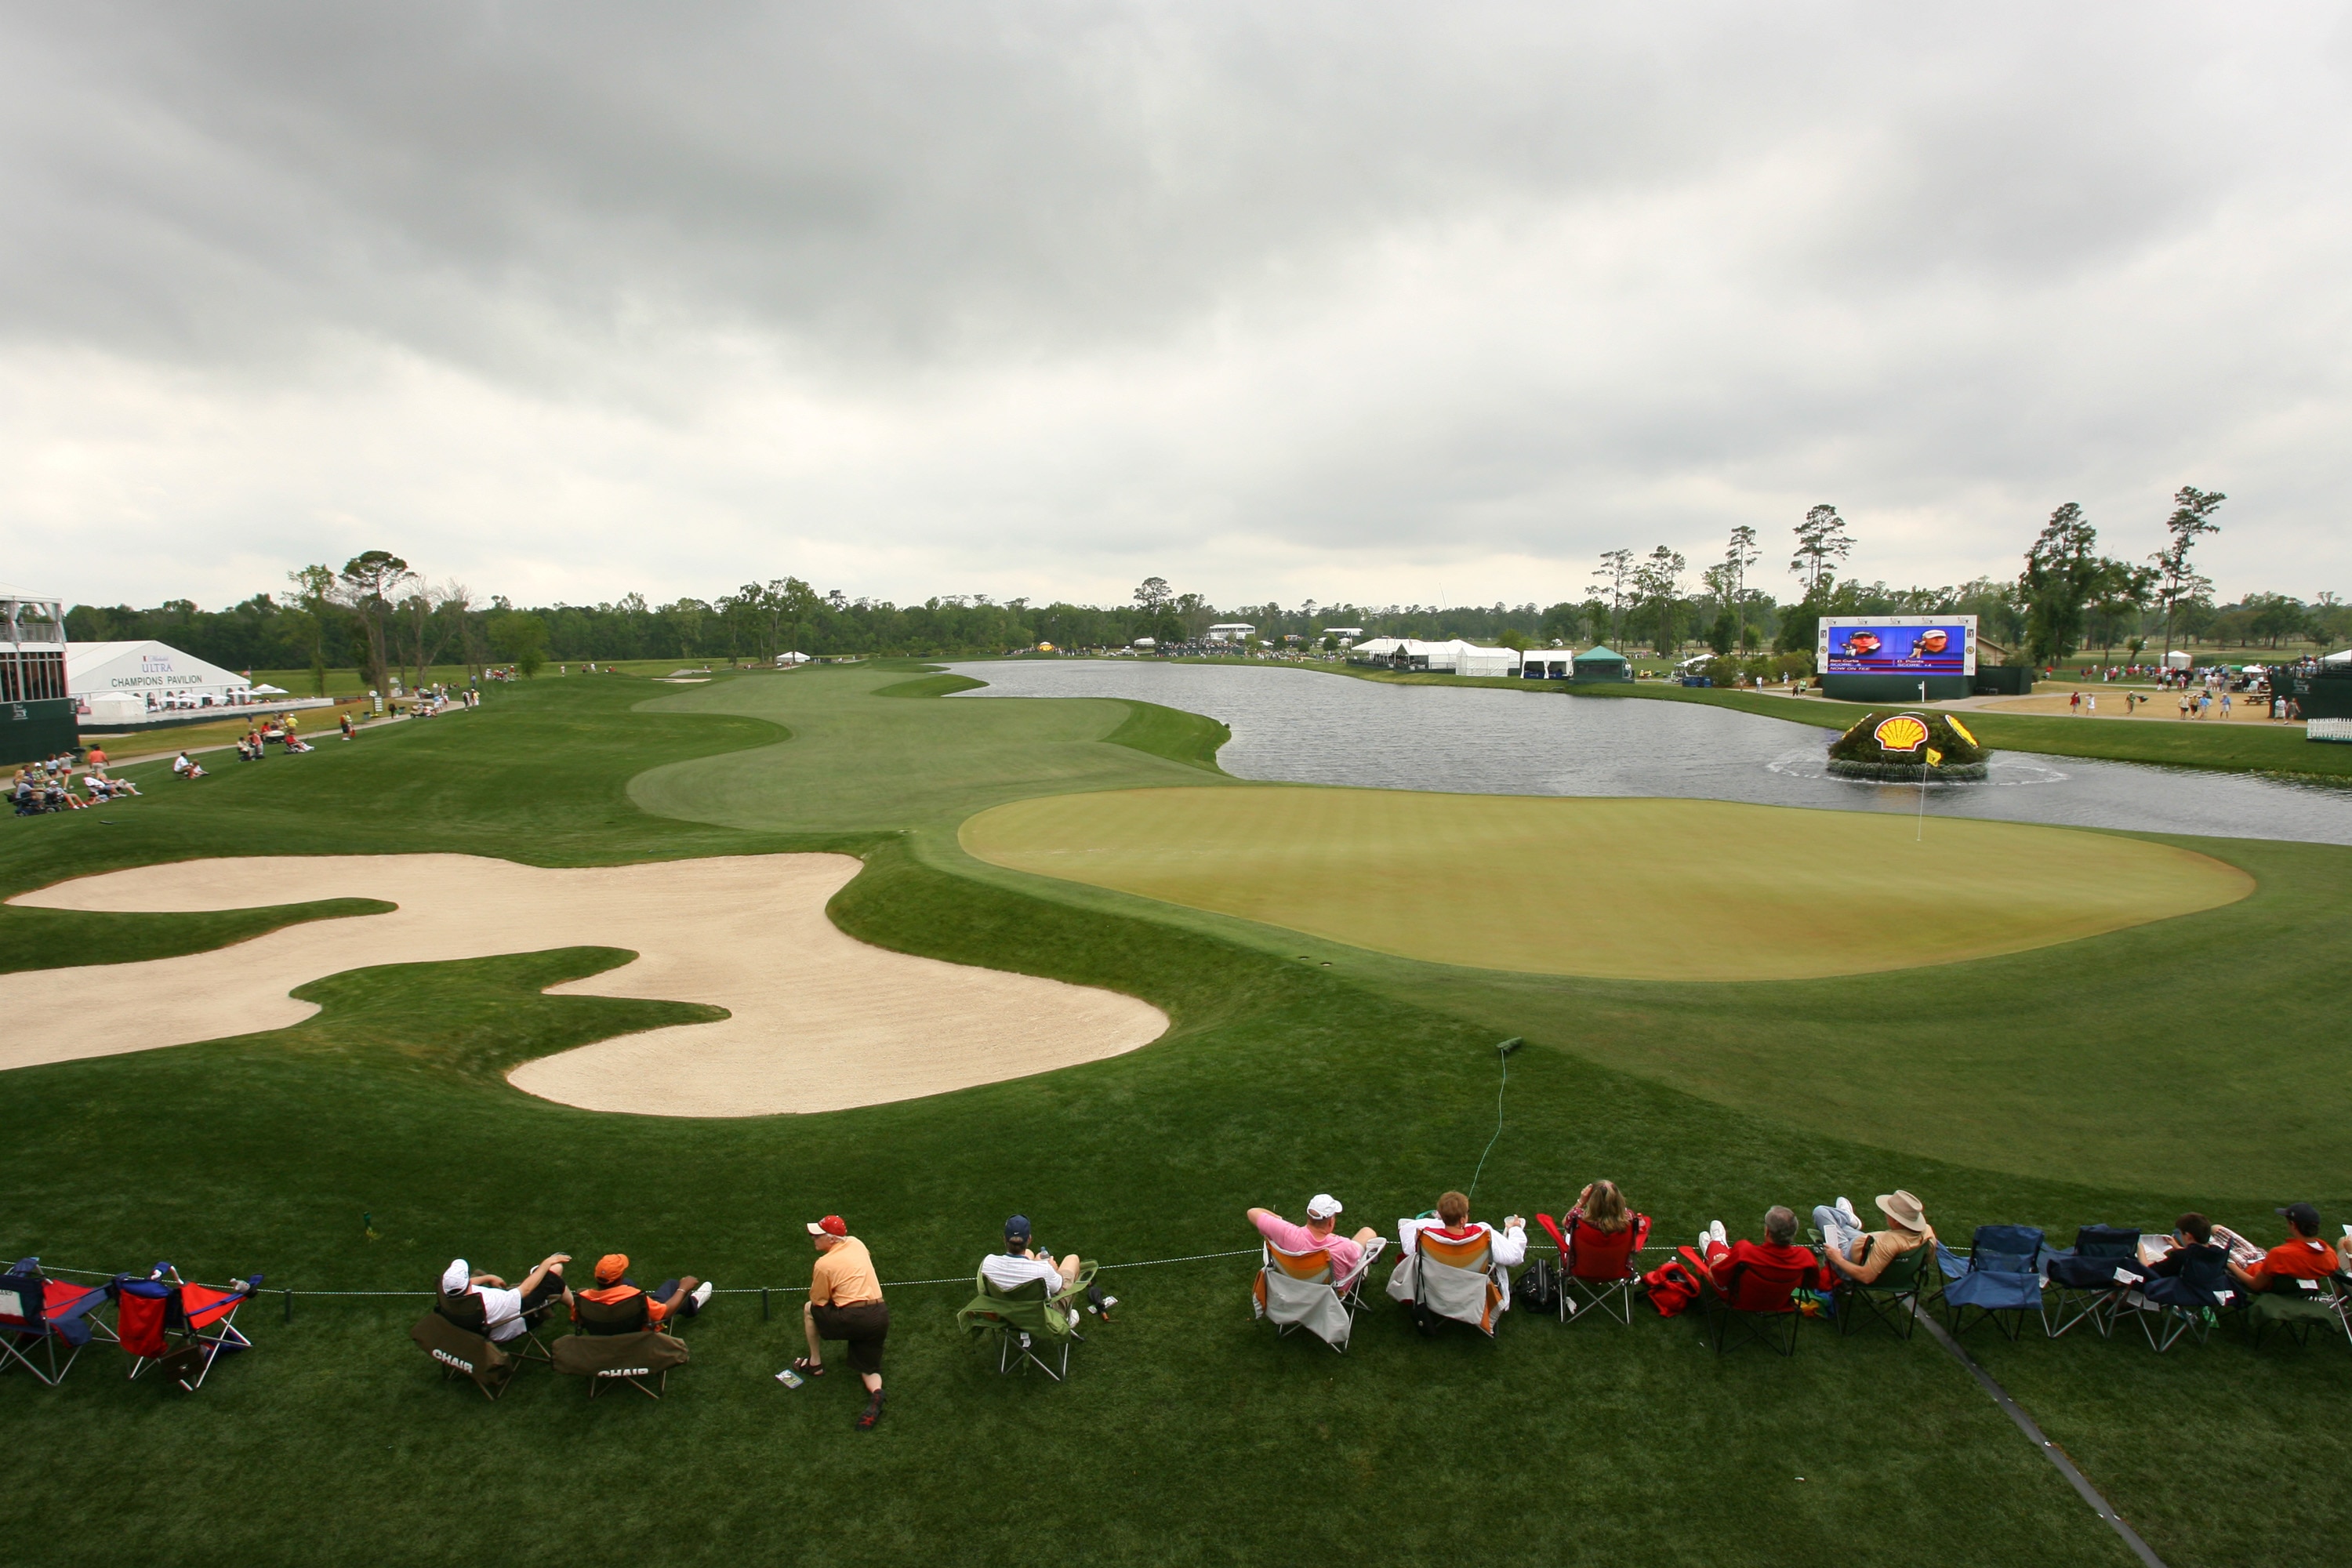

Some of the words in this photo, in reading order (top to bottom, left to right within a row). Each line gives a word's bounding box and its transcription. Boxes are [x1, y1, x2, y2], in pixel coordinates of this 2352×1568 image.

[142, 663, 172, 673] ULTRA
[111, 676, 163, 688] CHAMPIONS
[167, 675, 202, 684] PAVILION
[432, 1348, 474, 1373] CHAIR
